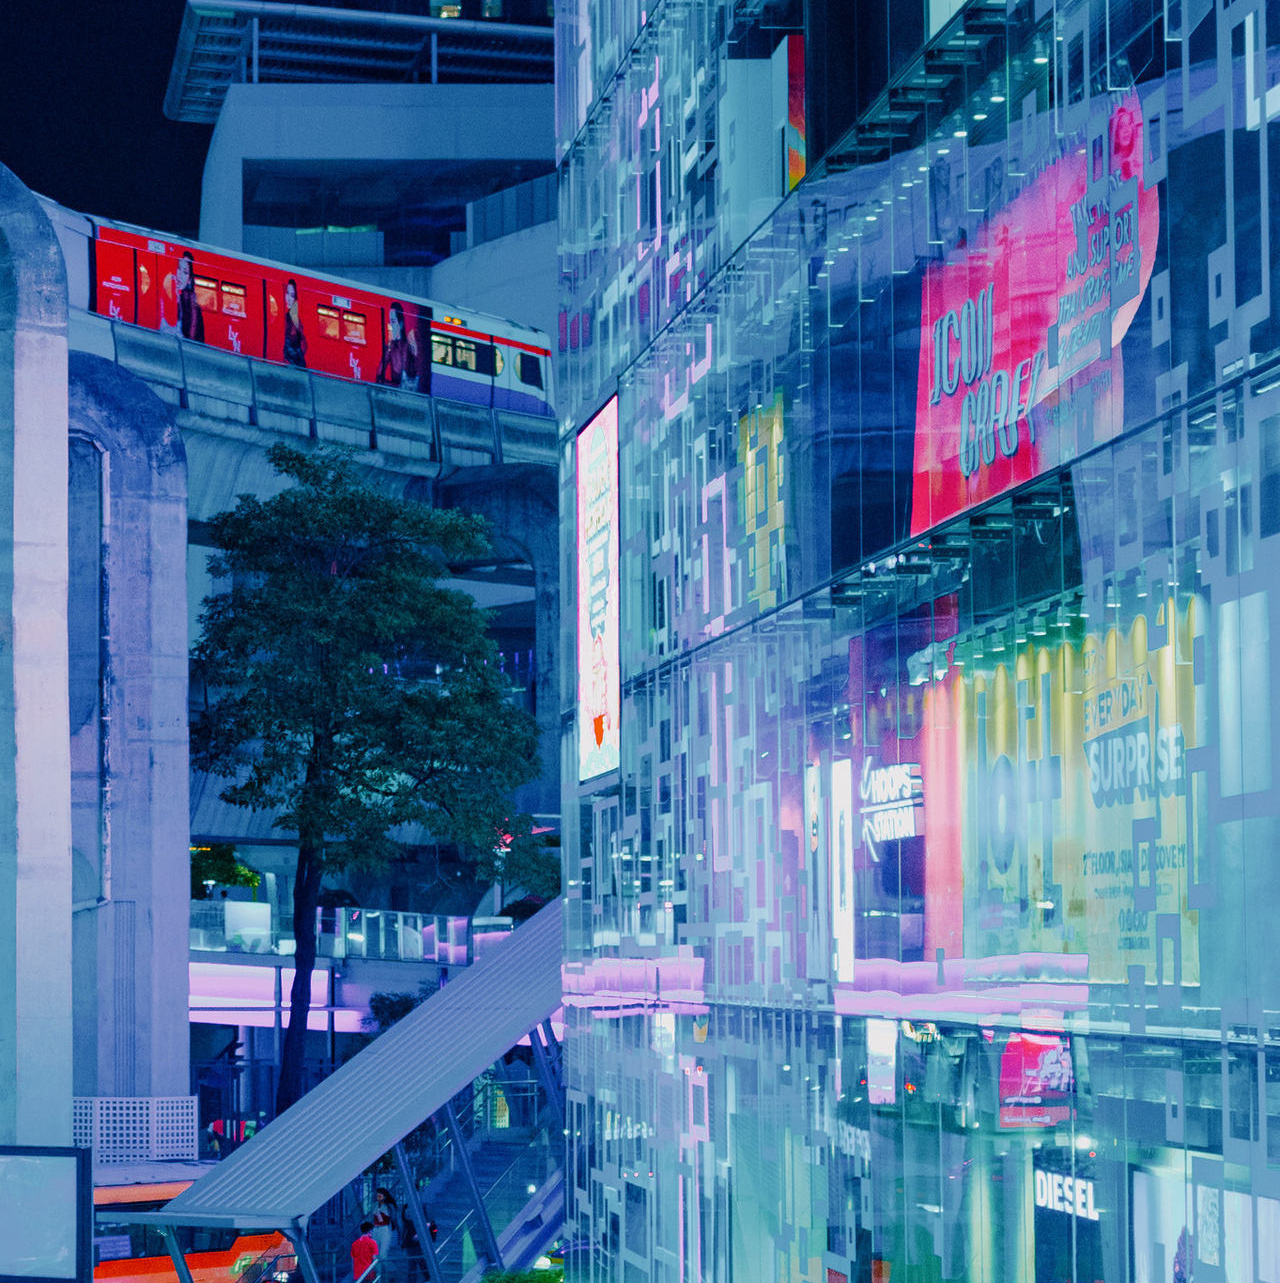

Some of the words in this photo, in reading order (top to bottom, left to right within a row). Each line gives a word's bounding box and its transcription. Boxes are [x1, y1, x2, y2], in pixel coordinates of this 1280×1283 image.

[1091, 209, 1135, 267] SUPORT
[1089, 725, 1182, 794] SURPRSE
[1035, 1169, 1099, 1221] DIESEL
